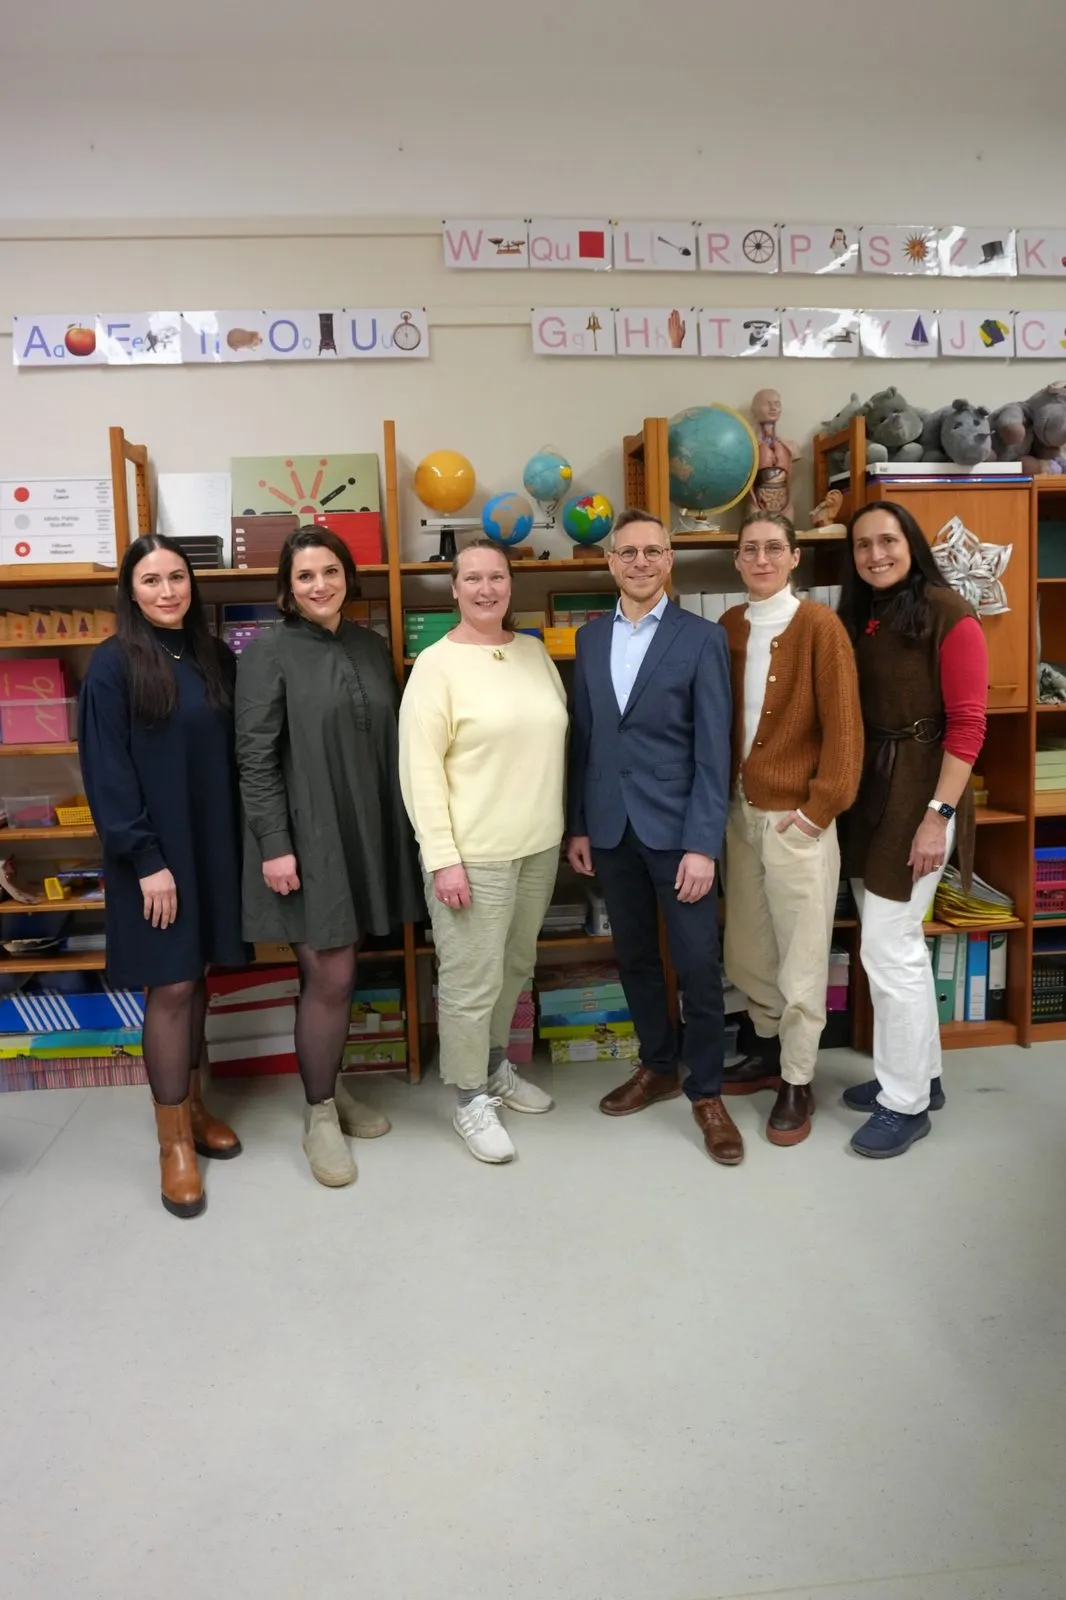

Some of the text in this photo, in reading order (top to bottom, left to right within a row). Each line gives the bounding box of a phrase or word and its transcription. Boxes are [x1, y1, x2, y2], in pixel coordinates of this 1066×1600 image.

[445, 229, 483, 262] W
[530, 236, 571, 262] Qu
[790, 234, 813, 265] P
[869, 235, 891, 266] S
[1024, 238, 1046, 268] K
[708, 318, 731, 349] T
[950, 320, 966, 350] J
[1022, 320, 1046, 351] C
